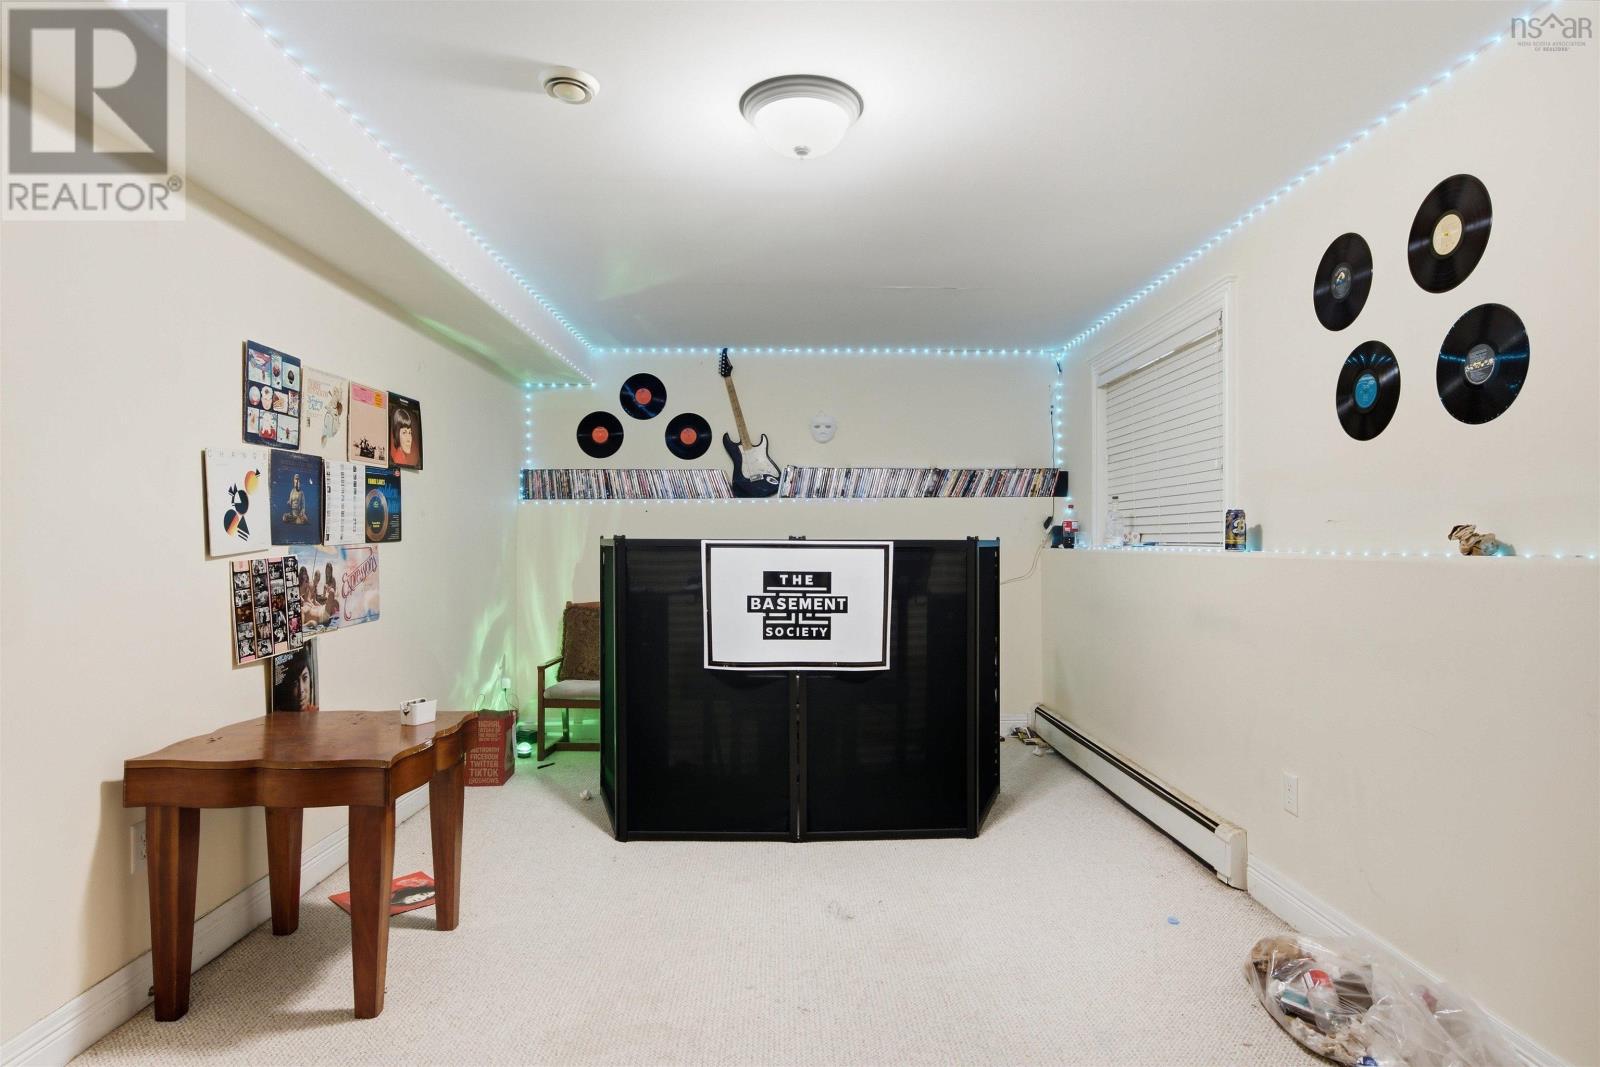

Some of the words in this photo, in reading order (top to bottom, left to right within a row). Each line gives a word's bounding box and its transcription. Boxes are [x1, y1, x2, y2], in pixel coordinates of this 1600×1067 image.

[779, 574, 814, 586] THE
[750, 597, 847, 611] BASEMENT
[765, 626, 829, 637] SOCIETY
[470, 760, 499, 768] TWITTER
[469, 768, 499, 777] TIKTOK
